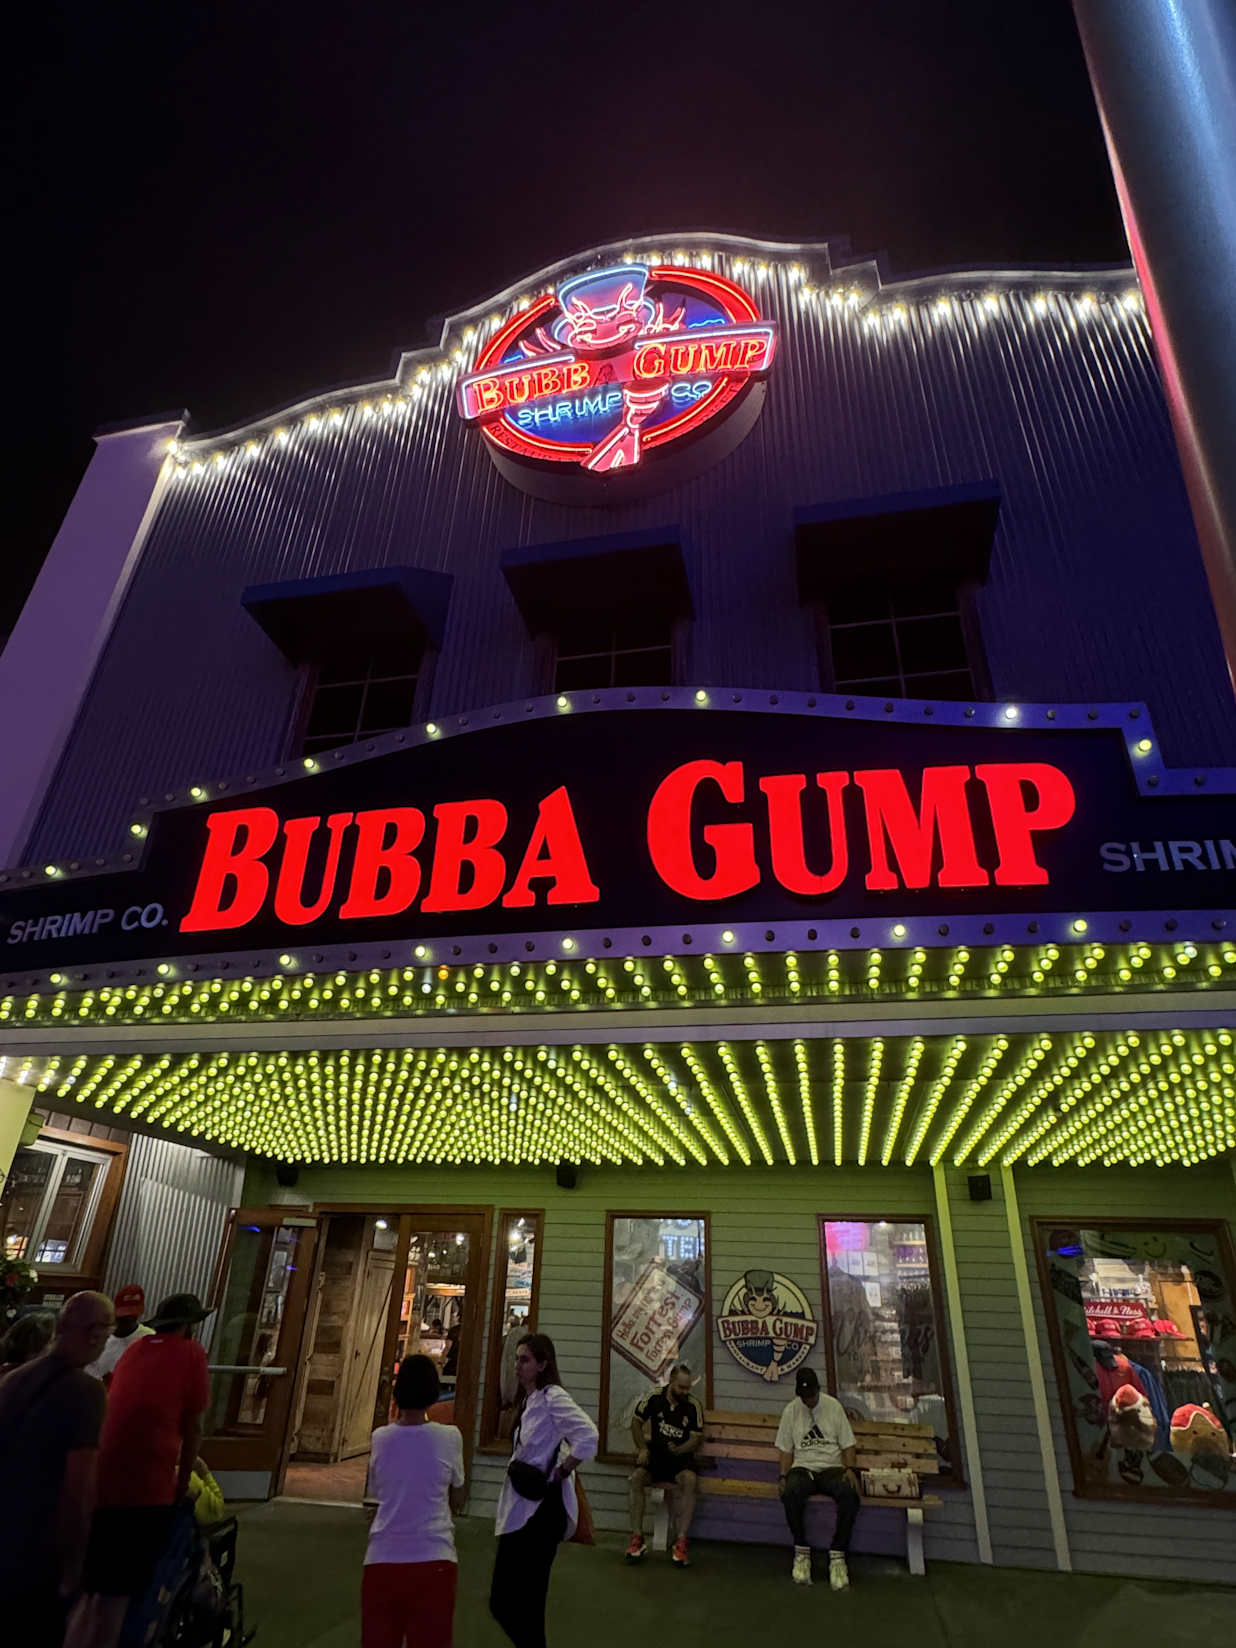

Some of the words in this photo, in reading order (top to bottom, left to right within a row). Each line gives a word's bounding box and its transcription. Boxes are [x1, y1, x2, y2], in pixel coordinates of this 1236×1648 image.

[633, 339, 767, 379] GUMP
[517, 392, 622, 426] SHRIMP
[179, 786, 600, 932] BUBBA
[647, 759, 1076, 901] GUMP
[7, 909, 115, 944] SHRIMP
[121, 903, 168, 931] CO.
[721, 1319, 769, 1338] BUBBA
[772, 1318, 815, 1342] GUMP
